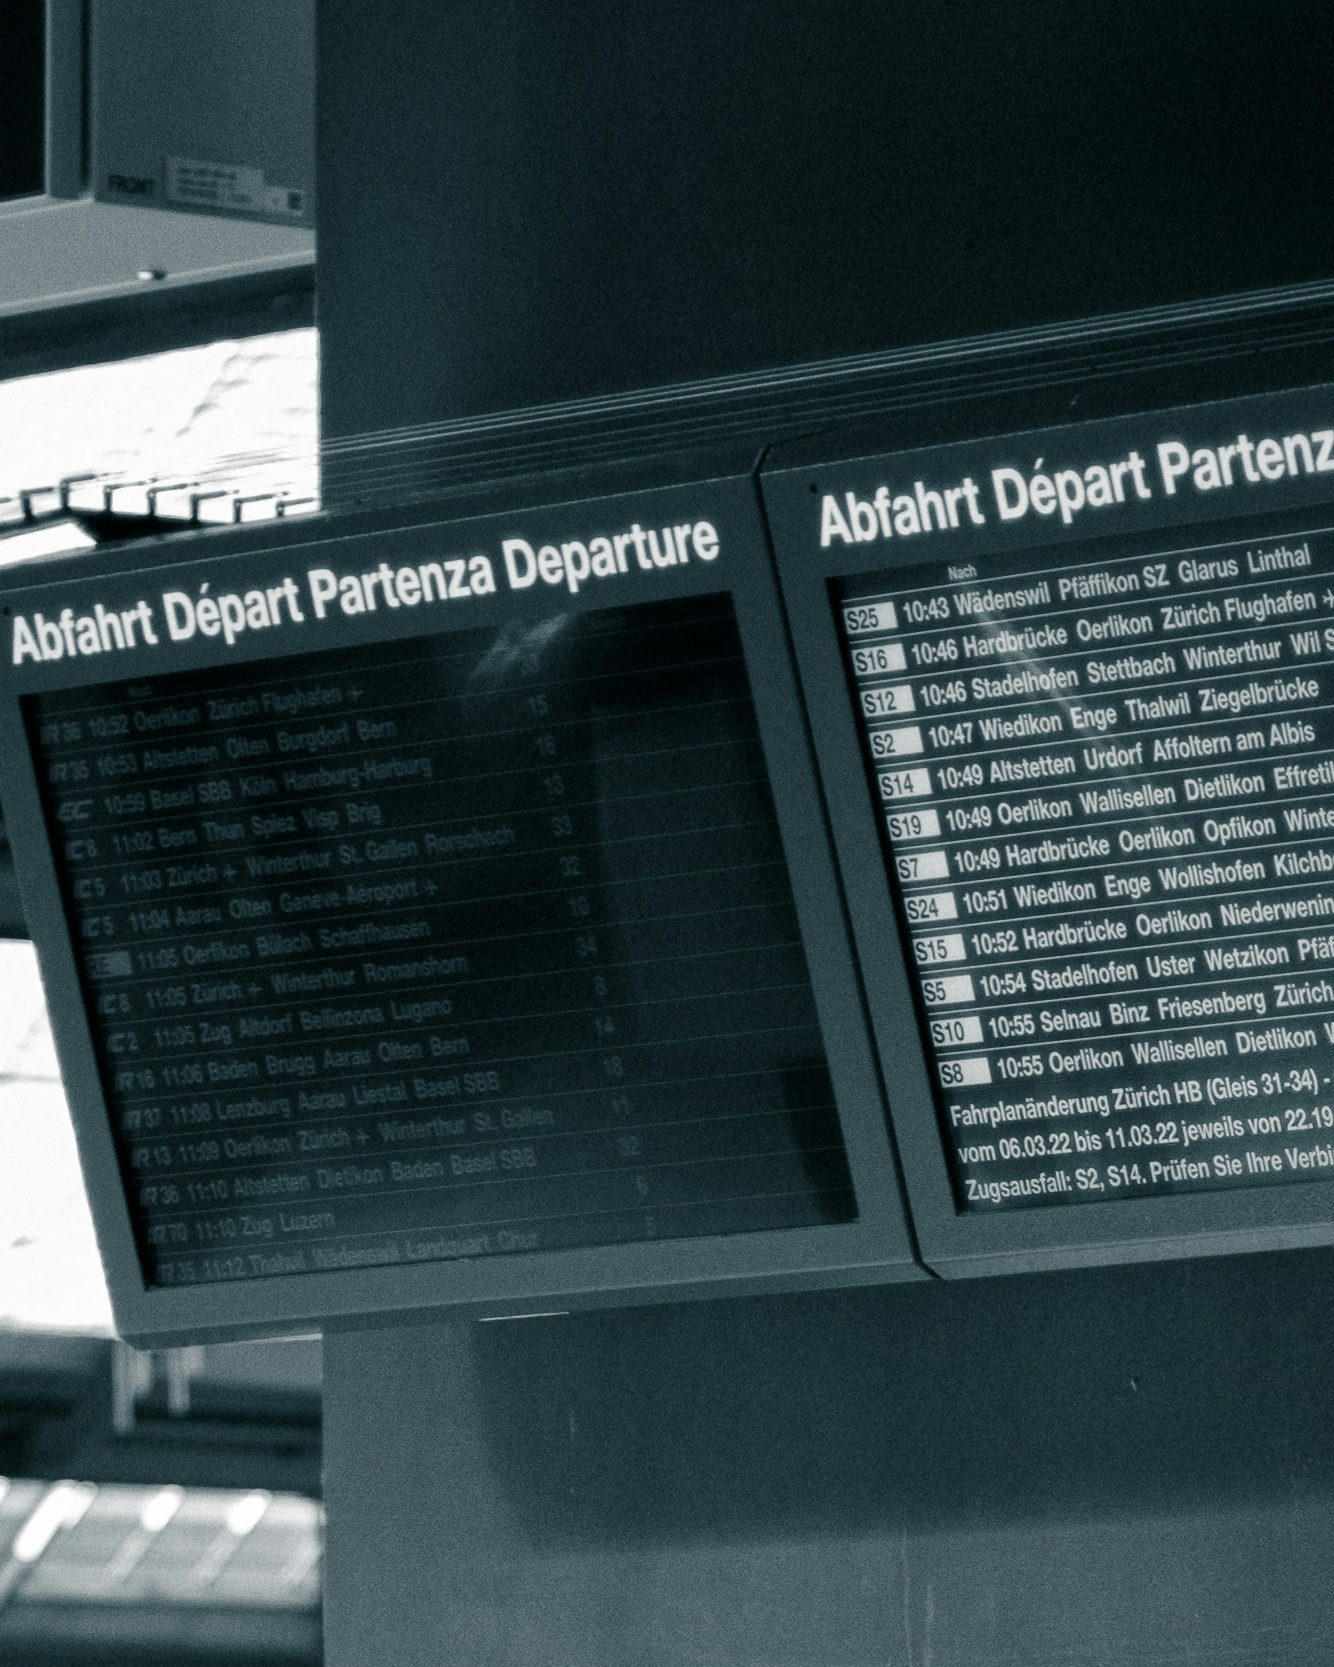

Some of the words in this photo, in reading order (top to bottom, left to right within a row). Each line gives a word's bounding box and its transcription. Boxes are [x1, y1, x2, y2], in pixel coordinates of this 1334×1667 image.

[819, 476, 987, 548] Abfahrt
[990, 450, 1153, 525] Départ
[11, 599, 160, 666] Abfahrt
[161, 576, 306, 646] Départ
[306, 554, 498, 620] Partenza
[500, 519, 721, 595] Departure
[845, 607, 879, 632] S25
[901, 595, 951, 624] 10:43
[951, 580, 1052, 620] Wädenswil
[1057, 571, 1141, 602] Pfäffikon
[1141, 562, 1172, 590] SZ
[1176, 557, 1240, 585] Glarus
[1245, 541, 1313, 575] Linthal
[946, 563, 978, 581] Nach
[853, 648, 888, 674] S16
[910, 637, 960, 666] 10:46
[961, 623, 1069, 659] Hardbrücke
[1075, 612, 1155, 643] Oerlikon
[1159, 600, 1223, 632] Zürich
[1222, 588, 1318, 624] Flughafen
[862, 690, 897, 715] S12
[918, 679, 968, 708] 10:46
[970, 666, 1080, 701] Stadelhofen
[1085, 650, 1177, 685] Stettbach
[1181, 638, 1283, 672] Winterthur
[1288, 629, 1323, 657] Wil
[871, 732, 897, 757] S2
[927, 720, 974, 749] 10:47
[977, 712, 1064, 742] Wiedikon
[1068, 705, 1119, 733] Enge
[1123, 690, 1192, 722] Thalwil
[1197, 675, 1321, 714] Ziegelbrücke
[879, 773, 914, 798] S14
[935, 762, 985, 791] 10:49
[989, 754, 1077, 785] Altstetten
[1082, 740, 1144, 772] Urdorf
[1152, 733, 1234, 763] Affoltern
[1234, 730, 1267, 752] am
[1268, 719, 1317, 748] Albis
[905, 898, 939, 922] S24
[961, 887, 1009, 915] 10:51
[1011, 879, 1098, 909] Wiedikon
[1102, 873, 1153, 901] Enge
[1156, 858, 1267, 892] Wollishofen
[912, 938, 948, 966] S15
[970, 928, 1020, 956] 10:52
[1021, 917, 1129, 951] Hardbrücke
[1134, 908, 1214, 937] Oerlikon
[920, 980, 947, 1007] S5
[978, 970, 1028, 998] 10:54
[1029, 959, 1140, 992] Stadelhofen
[1144, 954, 1197, 980] Uster
[1202, 943, 1291, 973] Wetzikon
[929, 1020, 965, 1048] S10
[987, 1012, 1037, 1039] 10:55
[1038, 1007, 1103, 1034] Selnau
[1107, 1001, 1152, 1027] Binz
[1155, 989, 1268, 1021] Friesenberg
[949, 1093, 1112, 1130] Fahrplanänderung
[1110, 1082, 1173, 1111] Zürich
[1172, 1079, 1204, 1105] HB
[1205, 1074, 1260, 1107] (Gleis
[1259, 1067, 1320, 1096] 31-34)
[957, 1143, 998, 1165] vom
[997, 1130, 1074, 1161] 06.03.22
[1072, 1128, 1104, 1153] bis
[1104, 1120, 1181, 1150] 11.03.22
[1179, 1114, 1246, 1148] jeweils
[1246, 1114, 1283, 1136] von
[1283, 1104, 1334, 1132] 22.19
[964, 1169, 1074, 1205] Zugsausfall:
[1073, 1166, 1106, 1193] S2,
[1105, 1162, 1148, 1188] S14.
[1147, 1157, 1212, 1184] Prüfen
[1211, 1152, 1244, 1178] Sie
[1244, 1150, 1284, 1174] Ihre
